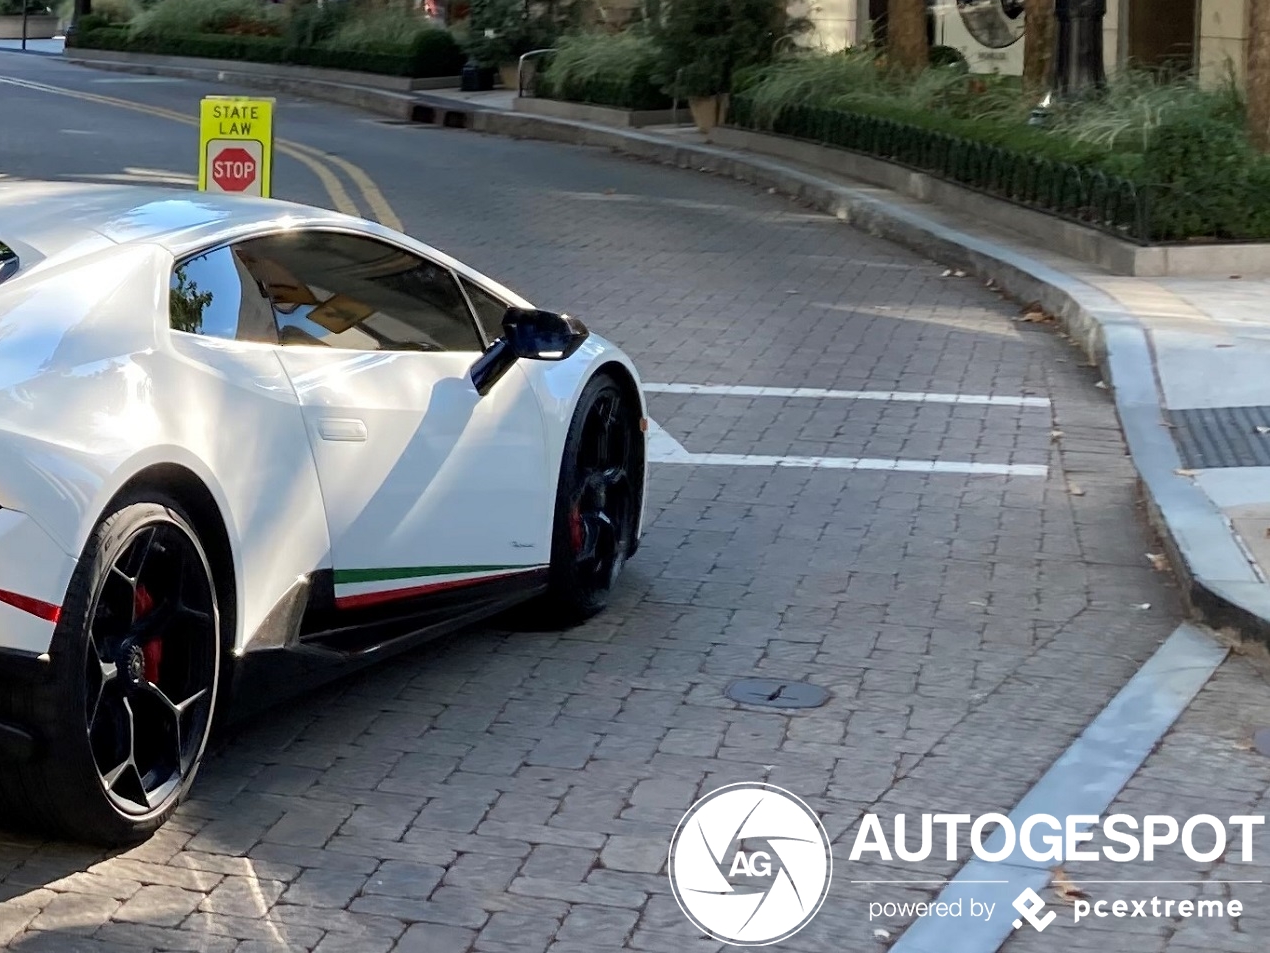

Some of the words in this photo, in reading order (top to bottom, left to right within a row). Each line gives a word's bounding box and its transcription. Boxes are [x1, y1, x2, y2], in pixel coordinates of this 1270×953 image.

[213, 105, 259, 120] STATE
[219, 122, 251, 136] LAW
[213, 160, 254, 179] STOP
